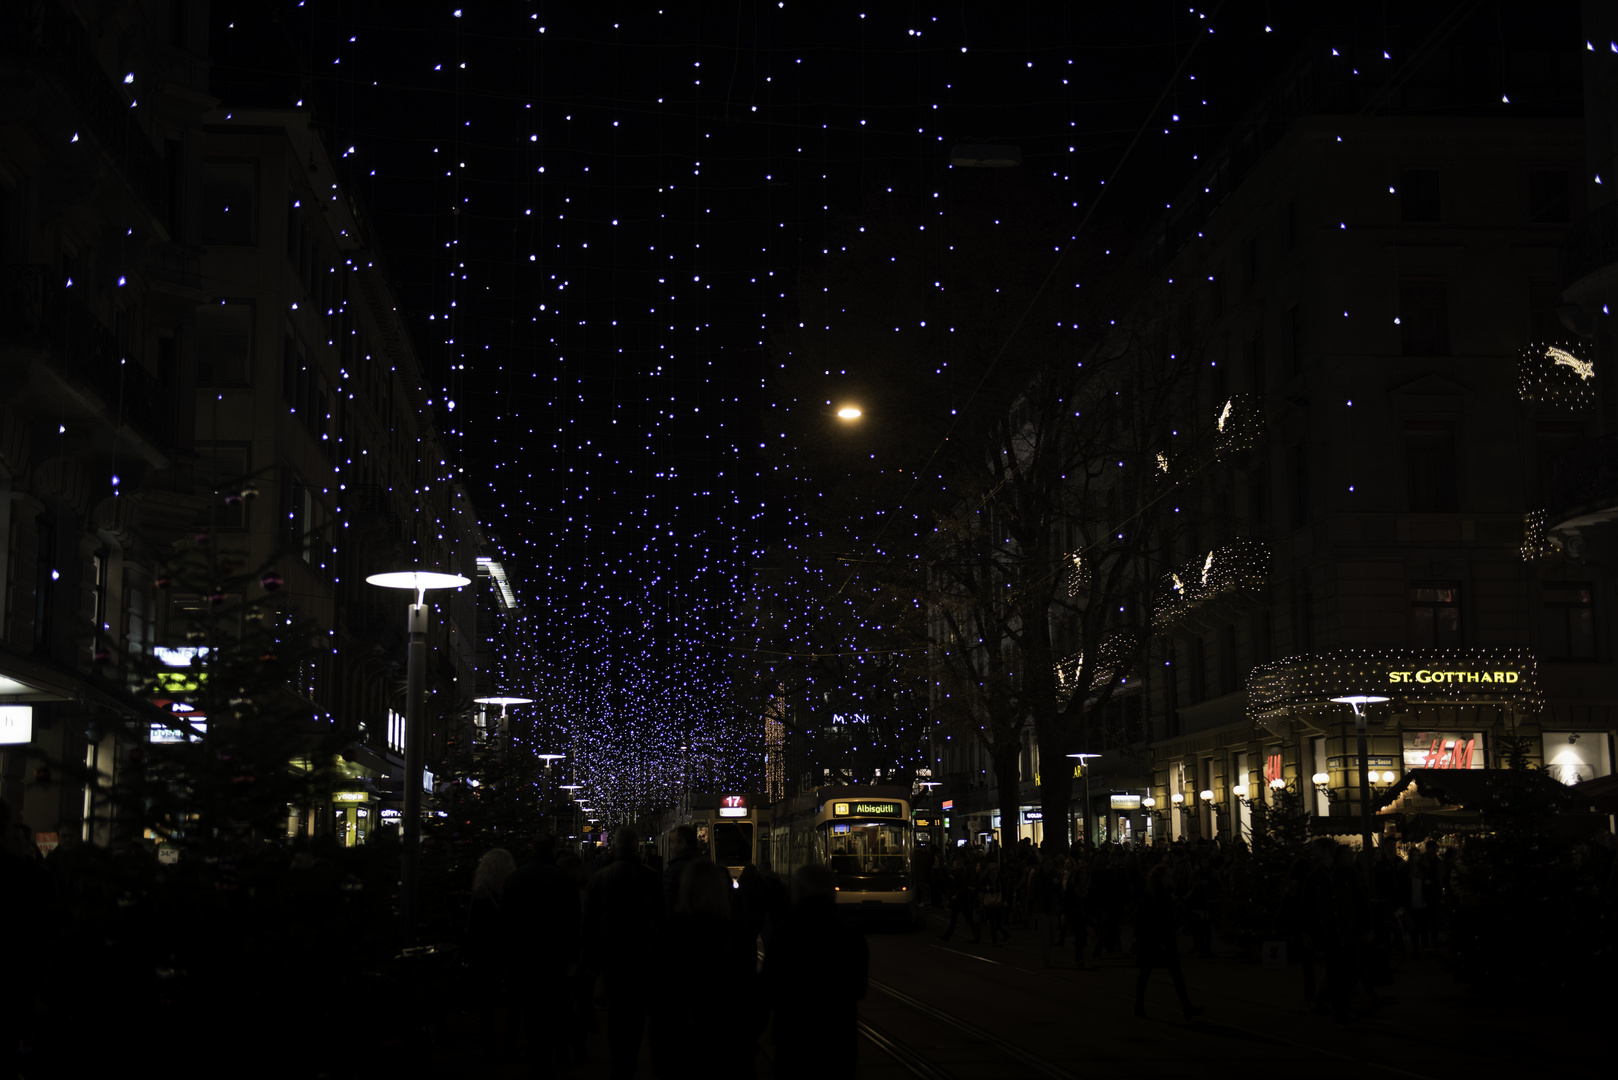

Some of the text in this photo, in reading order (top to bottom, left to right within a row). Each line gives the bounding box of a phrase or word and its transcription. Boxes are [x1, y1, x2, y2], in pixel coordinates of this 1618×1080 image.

[1389, 669, 1519, 684] ST. GOTTHARD
[727, 796, 740, 807] 17
[857, 804, 893, 814] Albisgütli
